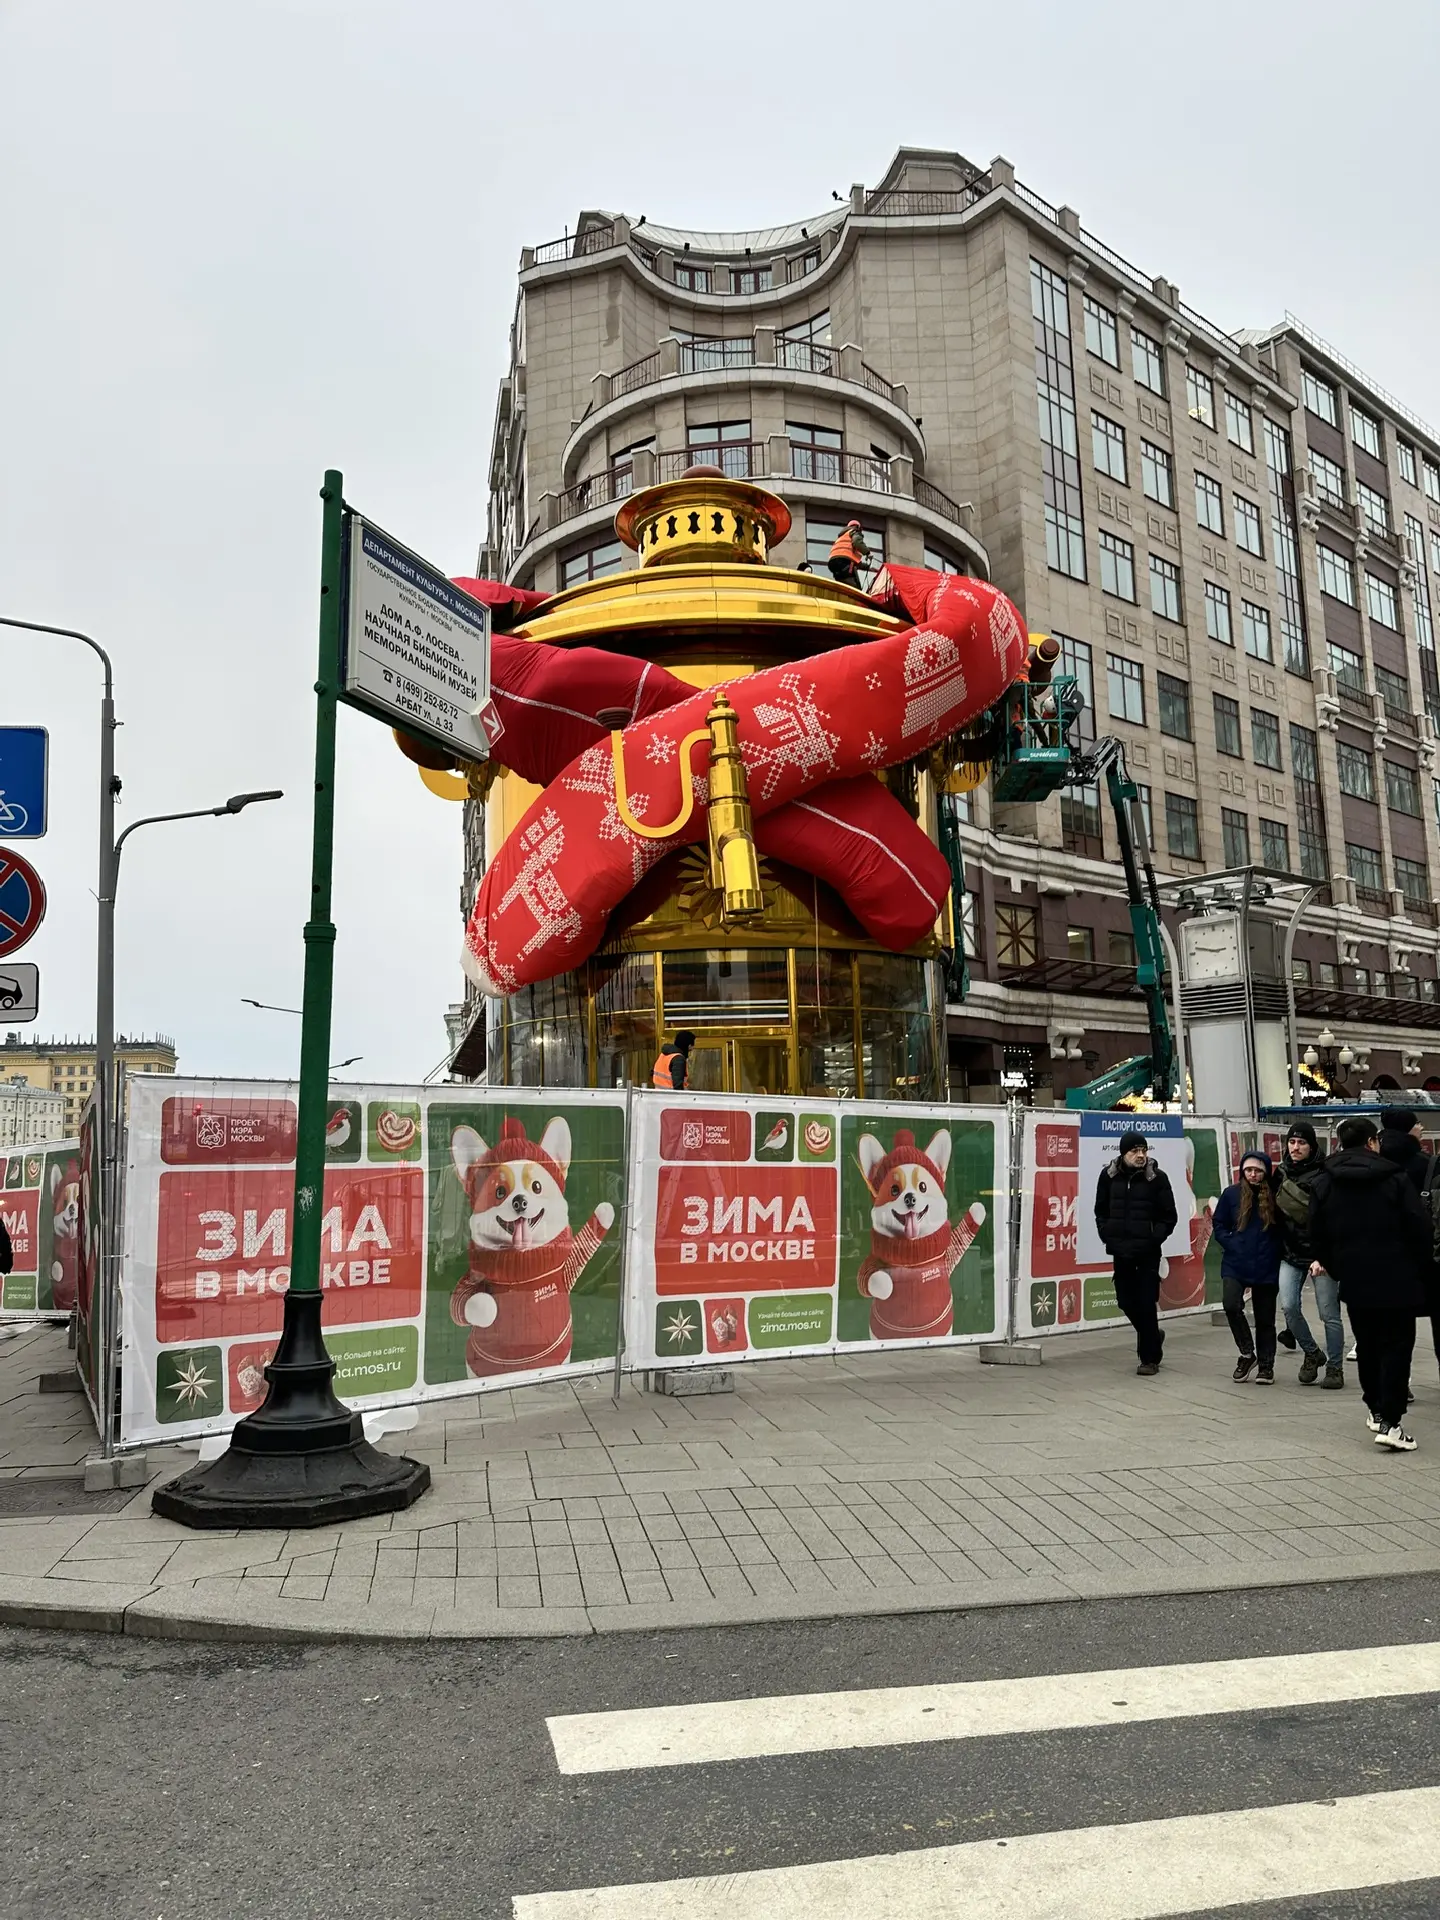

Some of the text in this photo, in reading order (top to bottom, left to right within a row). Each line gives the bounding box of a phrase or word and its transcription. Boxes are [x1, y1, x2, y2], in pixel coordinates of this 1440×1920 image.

[364, 538, 415, 578] ДЕПАРТАМЕНТ
[416, 572, 449, 602] КУЛЬТУРЫ
[454, 601, 483, 626] МОСКВЫ
[367, 560, 417, 600] ГОСУДАРСТВЕННОЕ
[418, 594, 448, 620] БЮДЖЕТНОЕ
[399, 591, 425, 615] КУЛЬТУРЫ
[430, 612, 453, 632] МОСКВЫ
[365, 609, 477, 686] НАУЧНАЯ БИБЛИОТЕКА И
[381, 603, 402, 625] ДОМ
[405, 619, 424, 638] А.Ф.
[425, 632, 460, 661] ЛОСЕВА
[364, 626, 477, 701] МЕМОРИАЛЬНЫЙ МУЗЕЙ
[395, 693, 422, 715] АРБАТ
[443, 719, 453, 732] 33
[396, 676, 458, 719] 8 (499) 252-82-72
[1102, 1120, 1167, 1132] ПАСПОРТ ОБЪЕКТА
[2, 1210, 28, 1235] МА
[681, 1196, 816, 1235] ЗИМА
[680, 1240, 816, 1263] В МОСКВЕ
[1046, 1234, 1056, 1252] В
[195, 1259, 391, 1298] В МОКВЕ
[760, 1320, 821, 1333] zima.mos.ru
[333, 1361, 401, 1379] a.mos.ru
[344, 1350, 371, 1360] больше
[373, 1349, 382, 1357] на
[383, 1346, 406, 1355] сайте:
